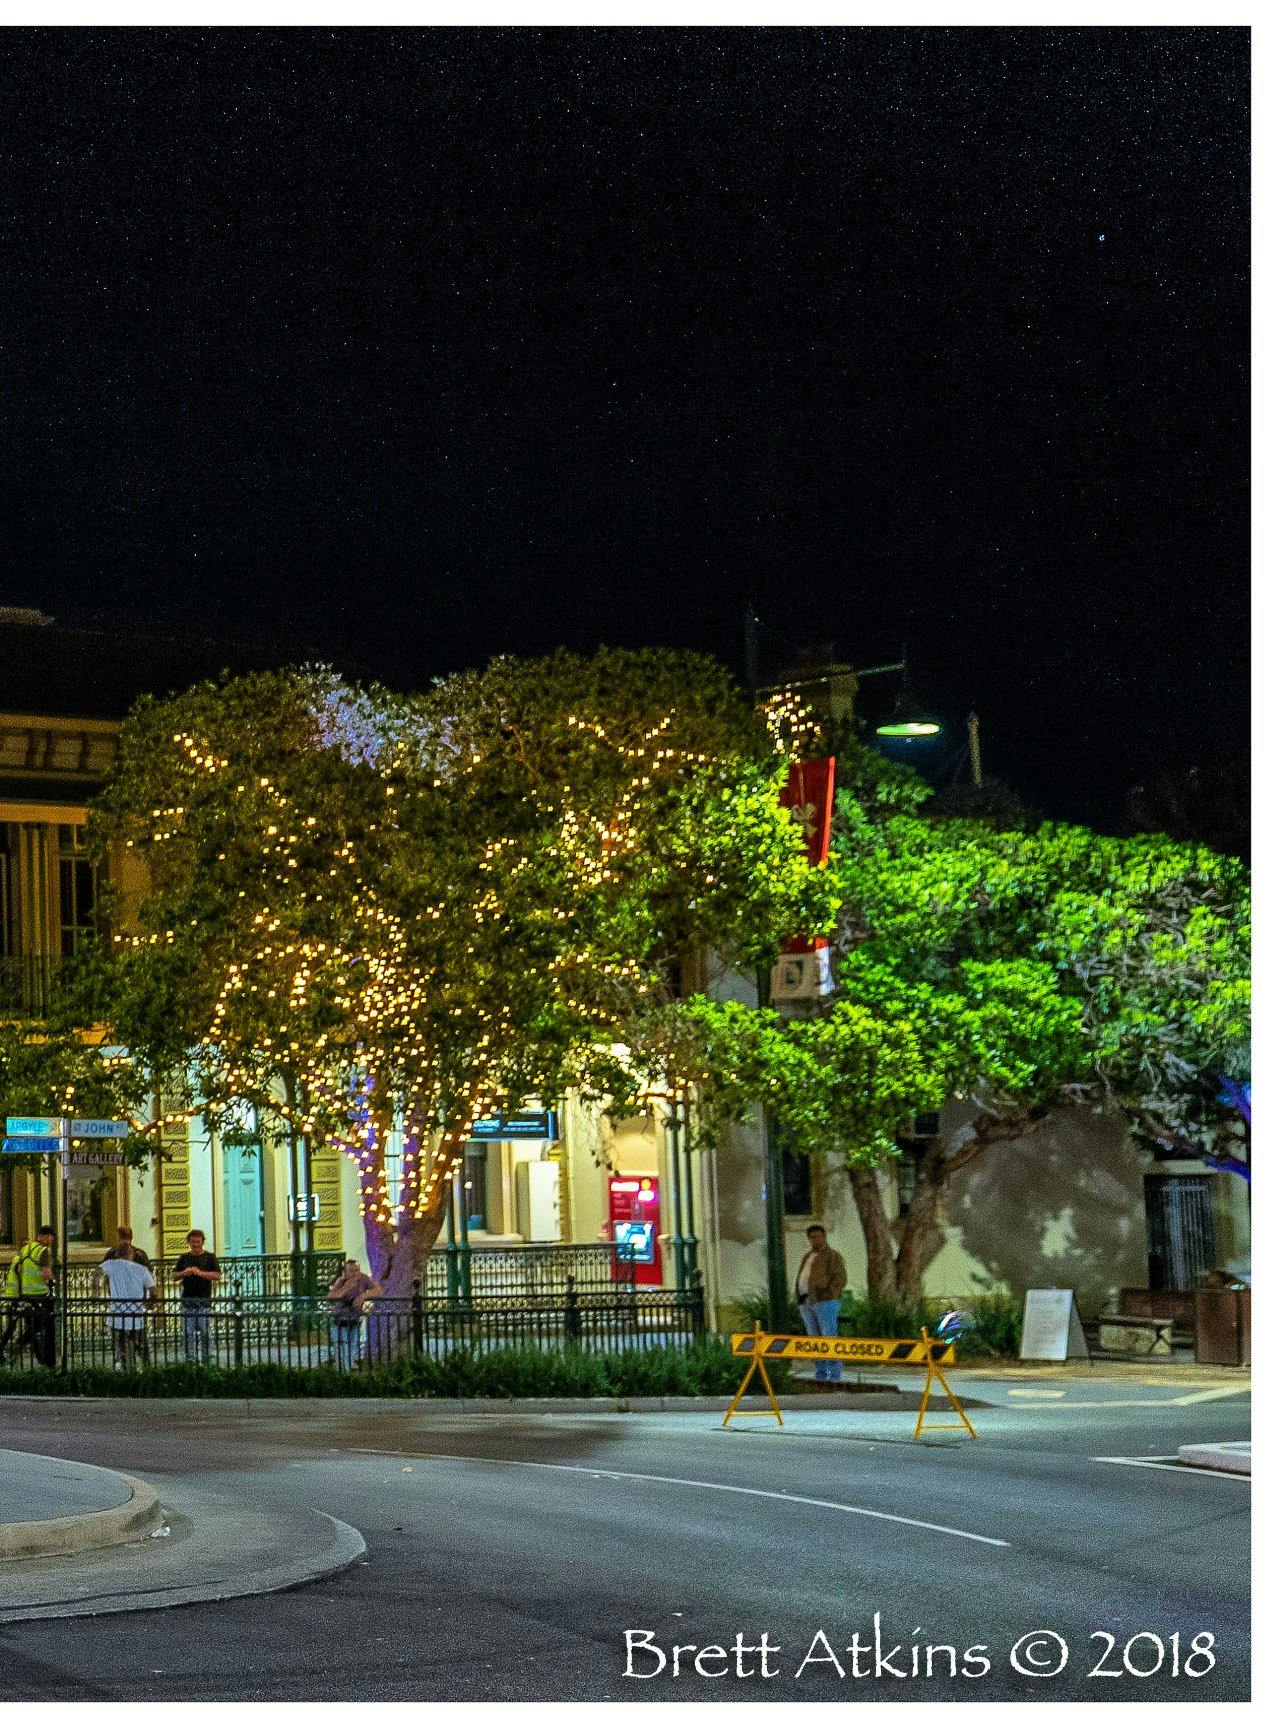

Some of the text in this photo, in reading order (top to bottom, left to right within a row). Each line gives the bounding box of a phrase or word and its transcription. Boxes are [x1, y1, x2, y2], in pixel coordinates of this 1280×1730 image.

[83, 1122, 114, 1134] JOHN
[72, 1153, 124, 1165] ART GALLERY
[794, 1340, 884, 1356] ROAD CLOSED
